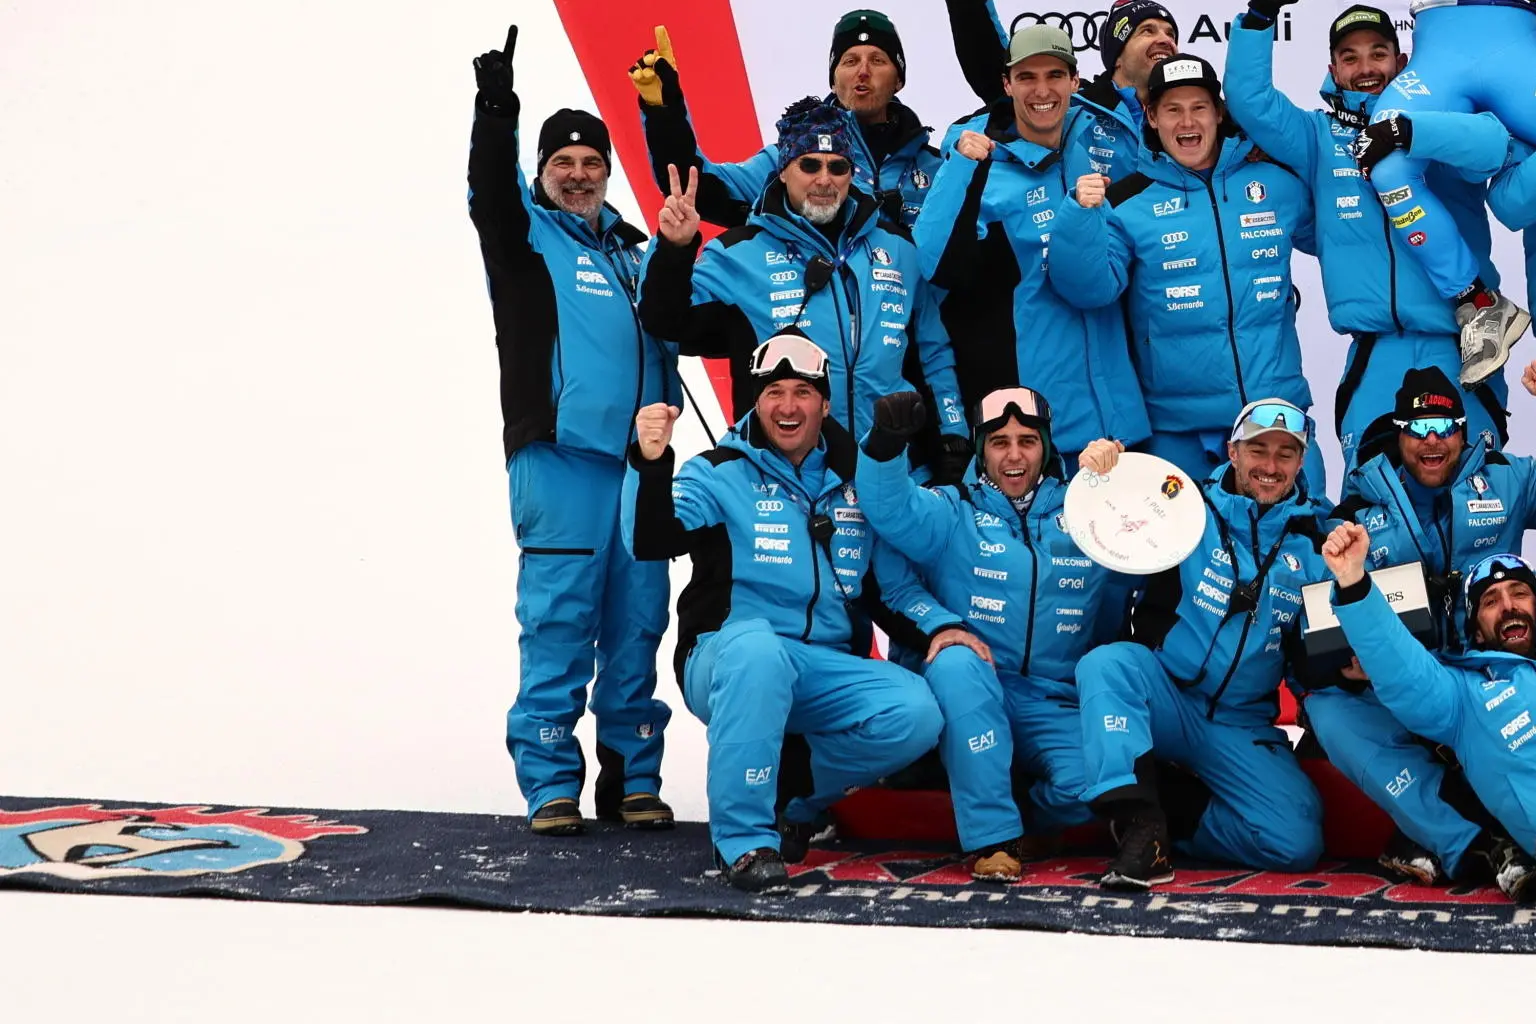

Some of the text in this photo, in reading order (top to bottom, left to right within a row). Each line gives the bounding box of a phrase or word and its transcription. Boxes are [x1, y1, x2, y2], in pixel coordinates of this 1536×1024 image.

[1026, 186, 1046, 203] EA7
[1336, 195, 1360, 209] FORST
[1153, 197, 1182, 215] EA7
[1240, 227, 1284, 240] FALCONERI
[1251, 244, 1279, 259] enel
[1166, 285, 1201, 298] FORST
[754, 537, 791, 551] FORST
[1473, 535, 1498, 548] enel
[753, 553, 793, 564] S.Bernardo
[838, 547, 862, 560] enel
[1052, 558, 1093, 568] FALCONERI
[1059, 576, 1085, 589] enel
[1197, 581, 1231, 604] FORST
[971, 596, 1006, 612] FORST
[967, 611, 1006, 624] S.Bernardo
[1104, 715, 1127, 730] EA7
[1500, 710, 1532, 739] FORST
[540, 726, 565, 741] EA7
[968, 729, 995, 749] EA7
[745, 766, 772, 783] EA7
[1386, 767, 1413, 797] EA7
